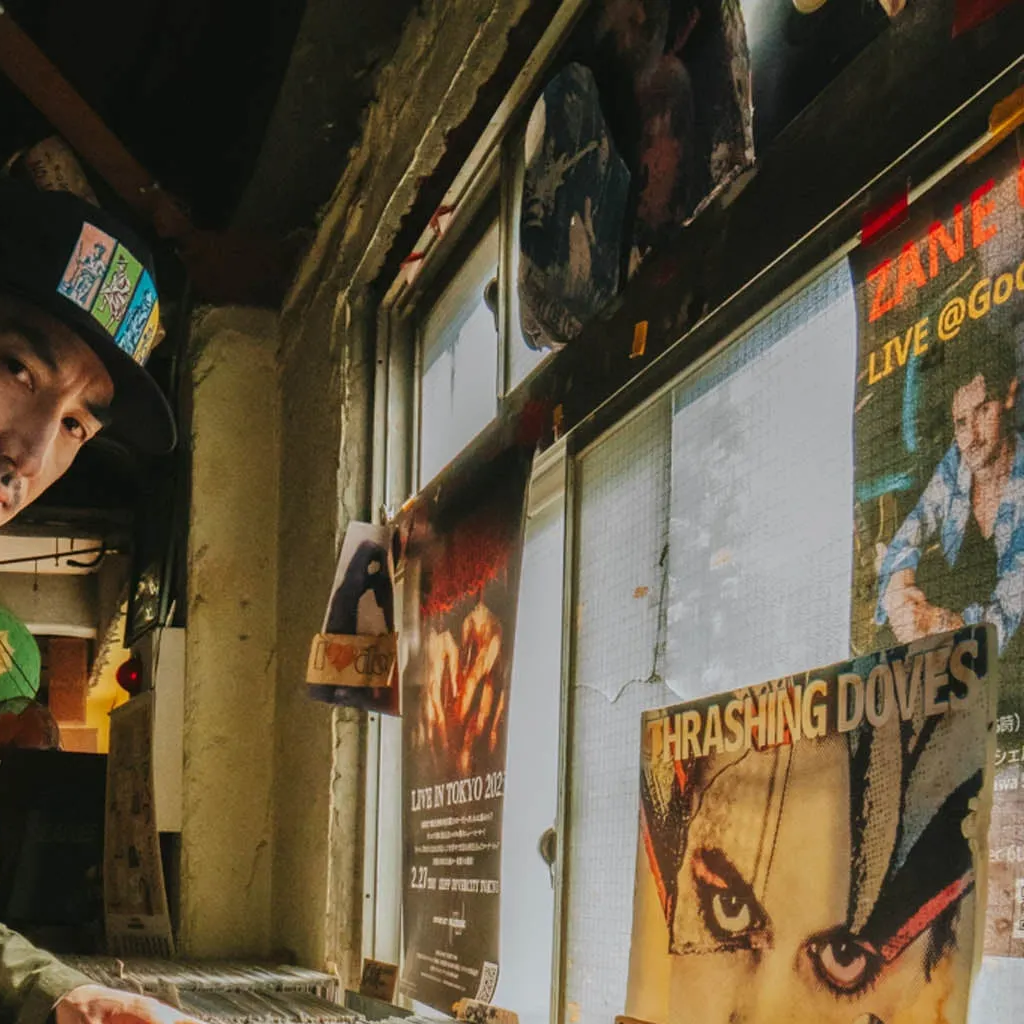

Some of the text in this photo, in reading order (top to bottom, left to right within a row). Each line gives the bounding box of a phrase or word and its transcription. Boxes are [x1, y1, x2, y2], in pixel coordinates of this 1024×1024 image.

[866, 178, 997, 323] ZANE
[868, 316, 929, 385] LIVE
[645, 639, 980, 763] THRASHING DOVES
[411, 770, 505, 812] LIVE IN TOKYO 202
